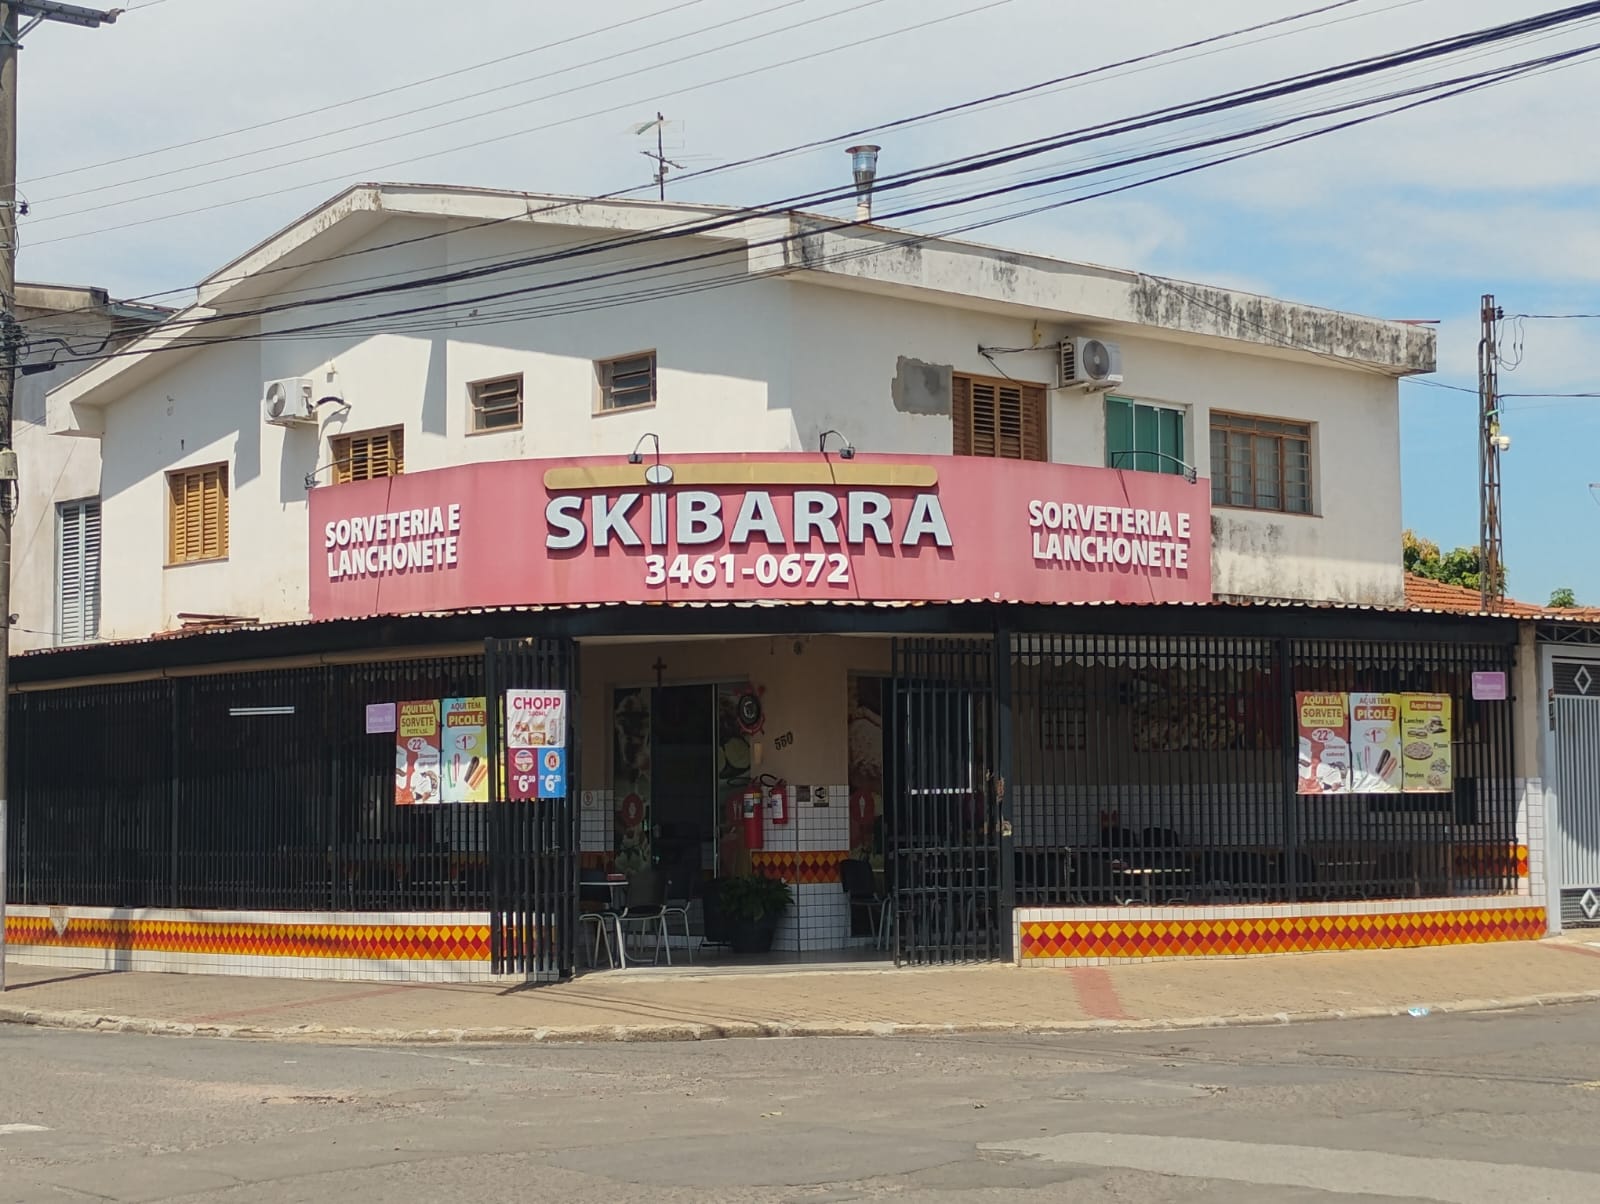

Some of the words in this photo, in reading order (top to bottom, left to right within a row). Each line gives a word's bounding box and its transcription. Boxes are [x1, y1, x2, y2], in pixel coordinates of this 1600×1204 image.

[325, 506, 444, 548] SORVETERIA
[448, 503, 460, 531] E
[544, 488, 953, 550] SKIBARRA
[1028, 499, 1173, 538] SORVETERIA
[1177, 512, 1191, 539] E
[327, 536, 458, 578] LANCHONETE
[1033, 532, 1188, 569] LANCHONETE
[644, 553, 849, 585] 3461-0672
[451, 702, 466, 711] AQUI
[513, 697, 561, 710] CHOPP
[1303, 696, 1325, 706] AQUI
[1359, 697, 1376, 705] AQUI
[401, 705, 419, 715] AQUI
[419, 704, 434, 714] TEM
[1303, 708, 1342, 718] SORVETE
[1357, 707, 1394, 720] PICOLÉ
[401, 717, 434, 727] SORVETE
[448, 712, 484, 726] PICOLÉ
